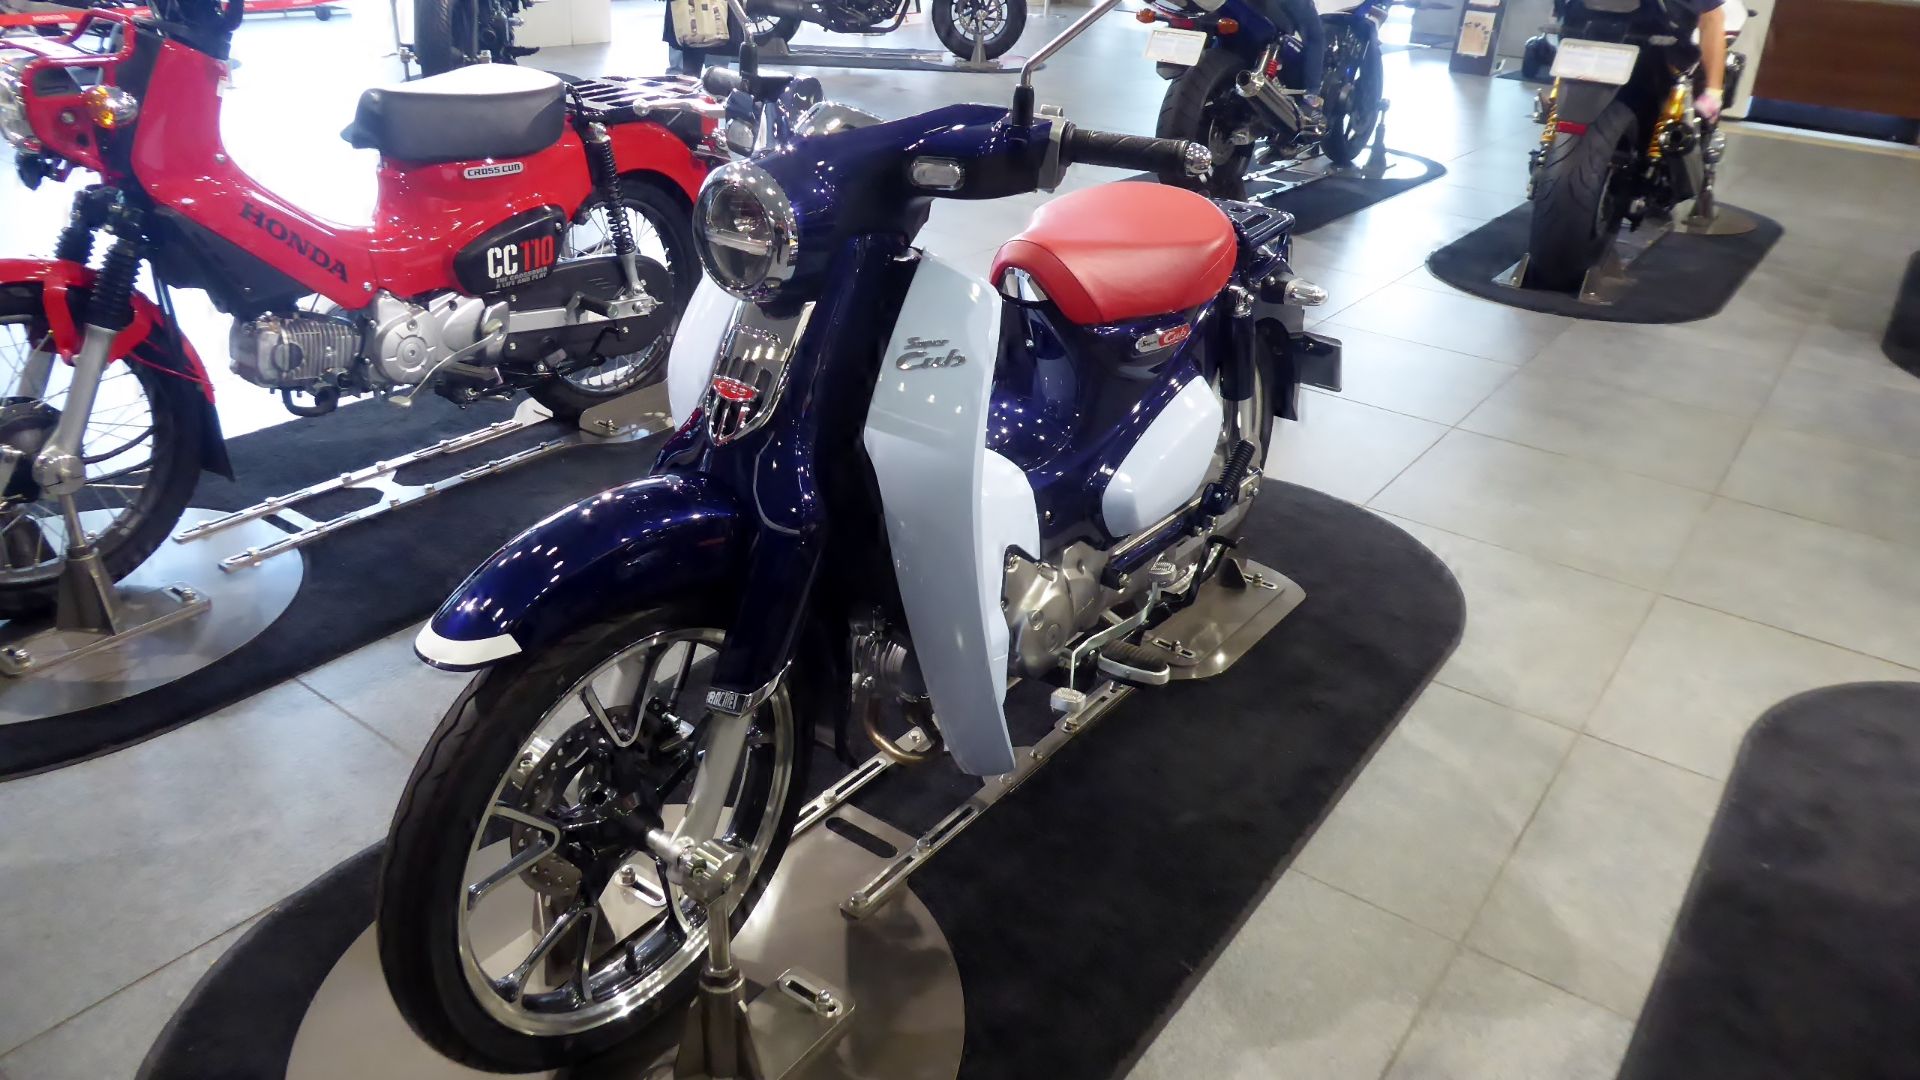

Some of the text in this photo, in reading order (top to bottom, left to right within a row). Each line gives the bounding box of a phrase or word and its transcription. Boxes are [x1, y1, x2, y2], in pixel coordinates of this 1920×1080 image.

[467, 163, 521, 176] CROSS CUB
[240, 202, 348, 283] HONDA
[896, 348, 966, 370] Cub
